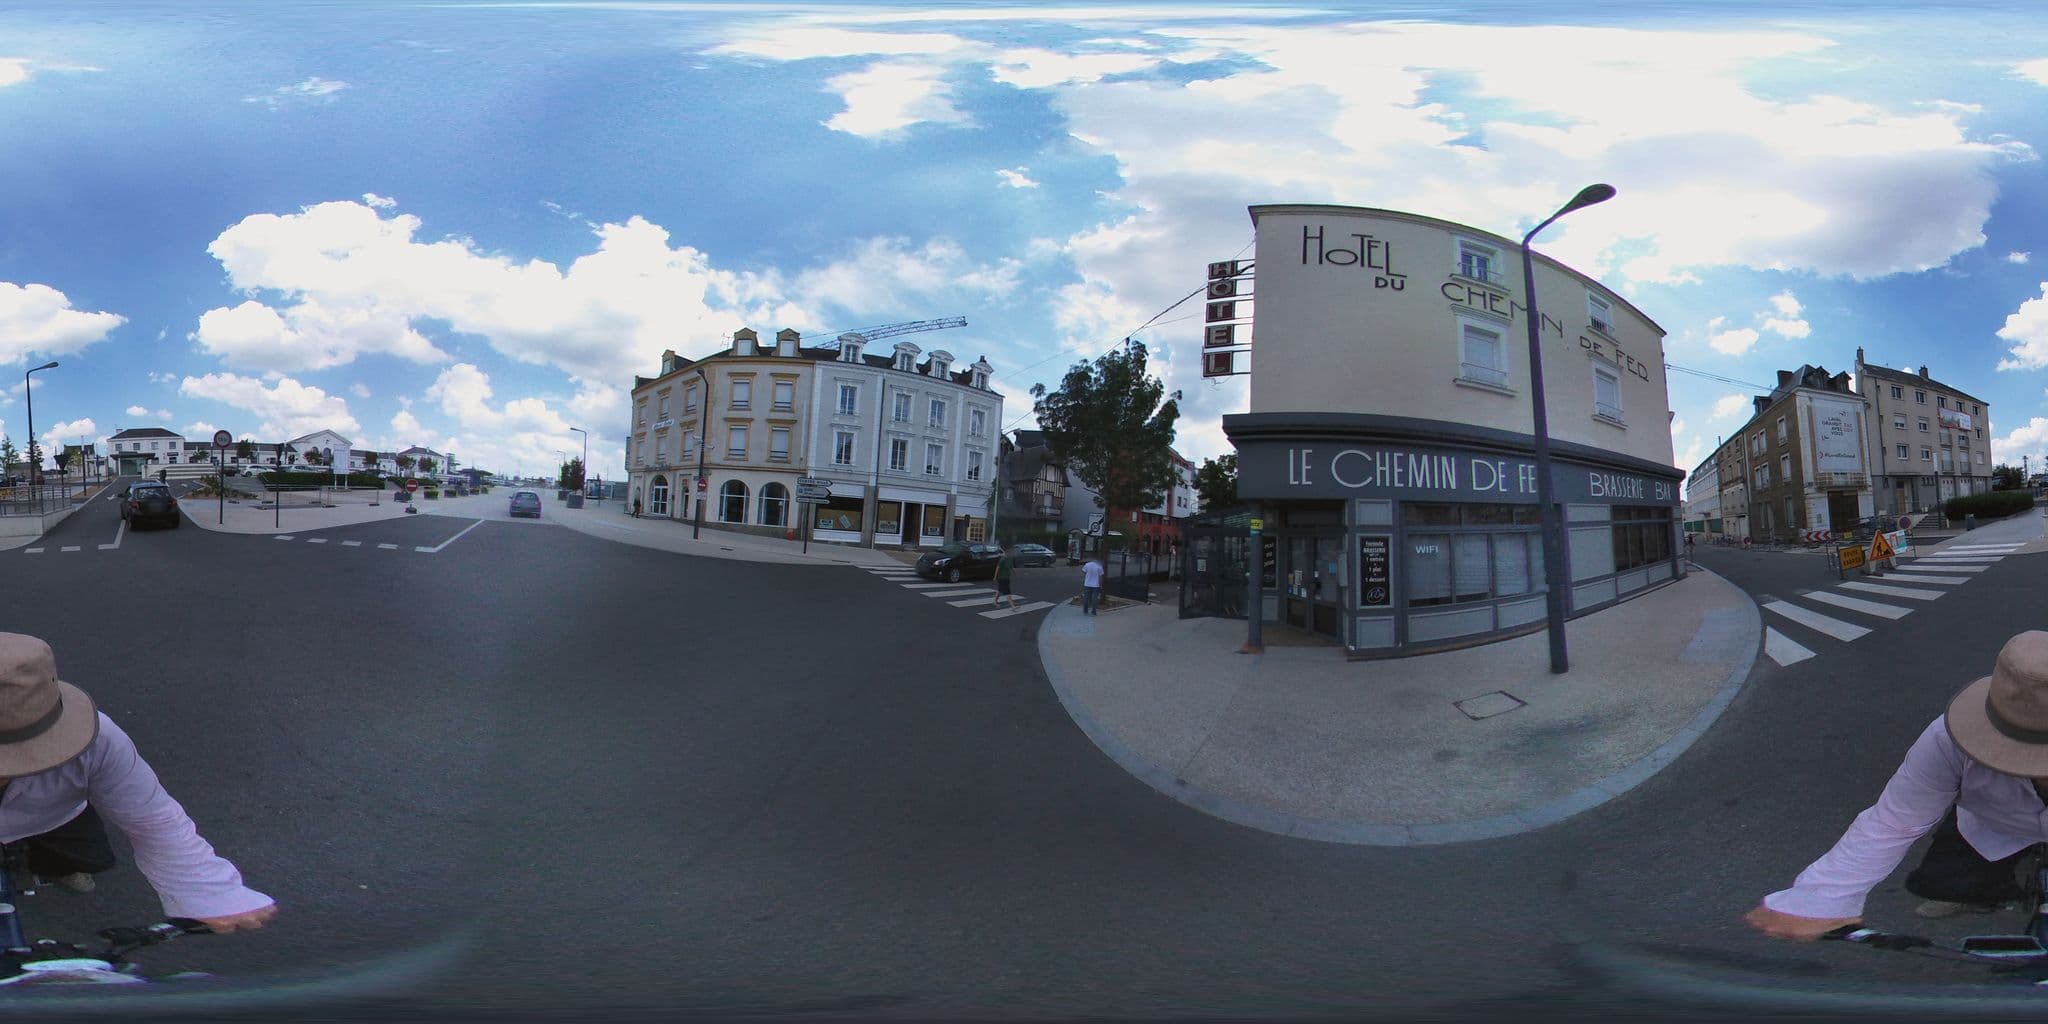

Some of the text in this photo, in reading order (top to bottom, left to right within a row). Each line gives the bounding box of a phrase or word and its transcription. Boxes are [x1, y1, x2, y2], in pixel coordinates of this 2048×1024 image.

[1374, 276, 1405, 291] DU
[1205, 260, 1236, 375] HOTEL
[1579, 335, 1604, 357] DE
[1289, 449, 1537, 494] LE CHEMIN DE FE
[1589, 472, 1645, 500] BRASSERIE
[1415, 545, 1441, 554] WIFI
